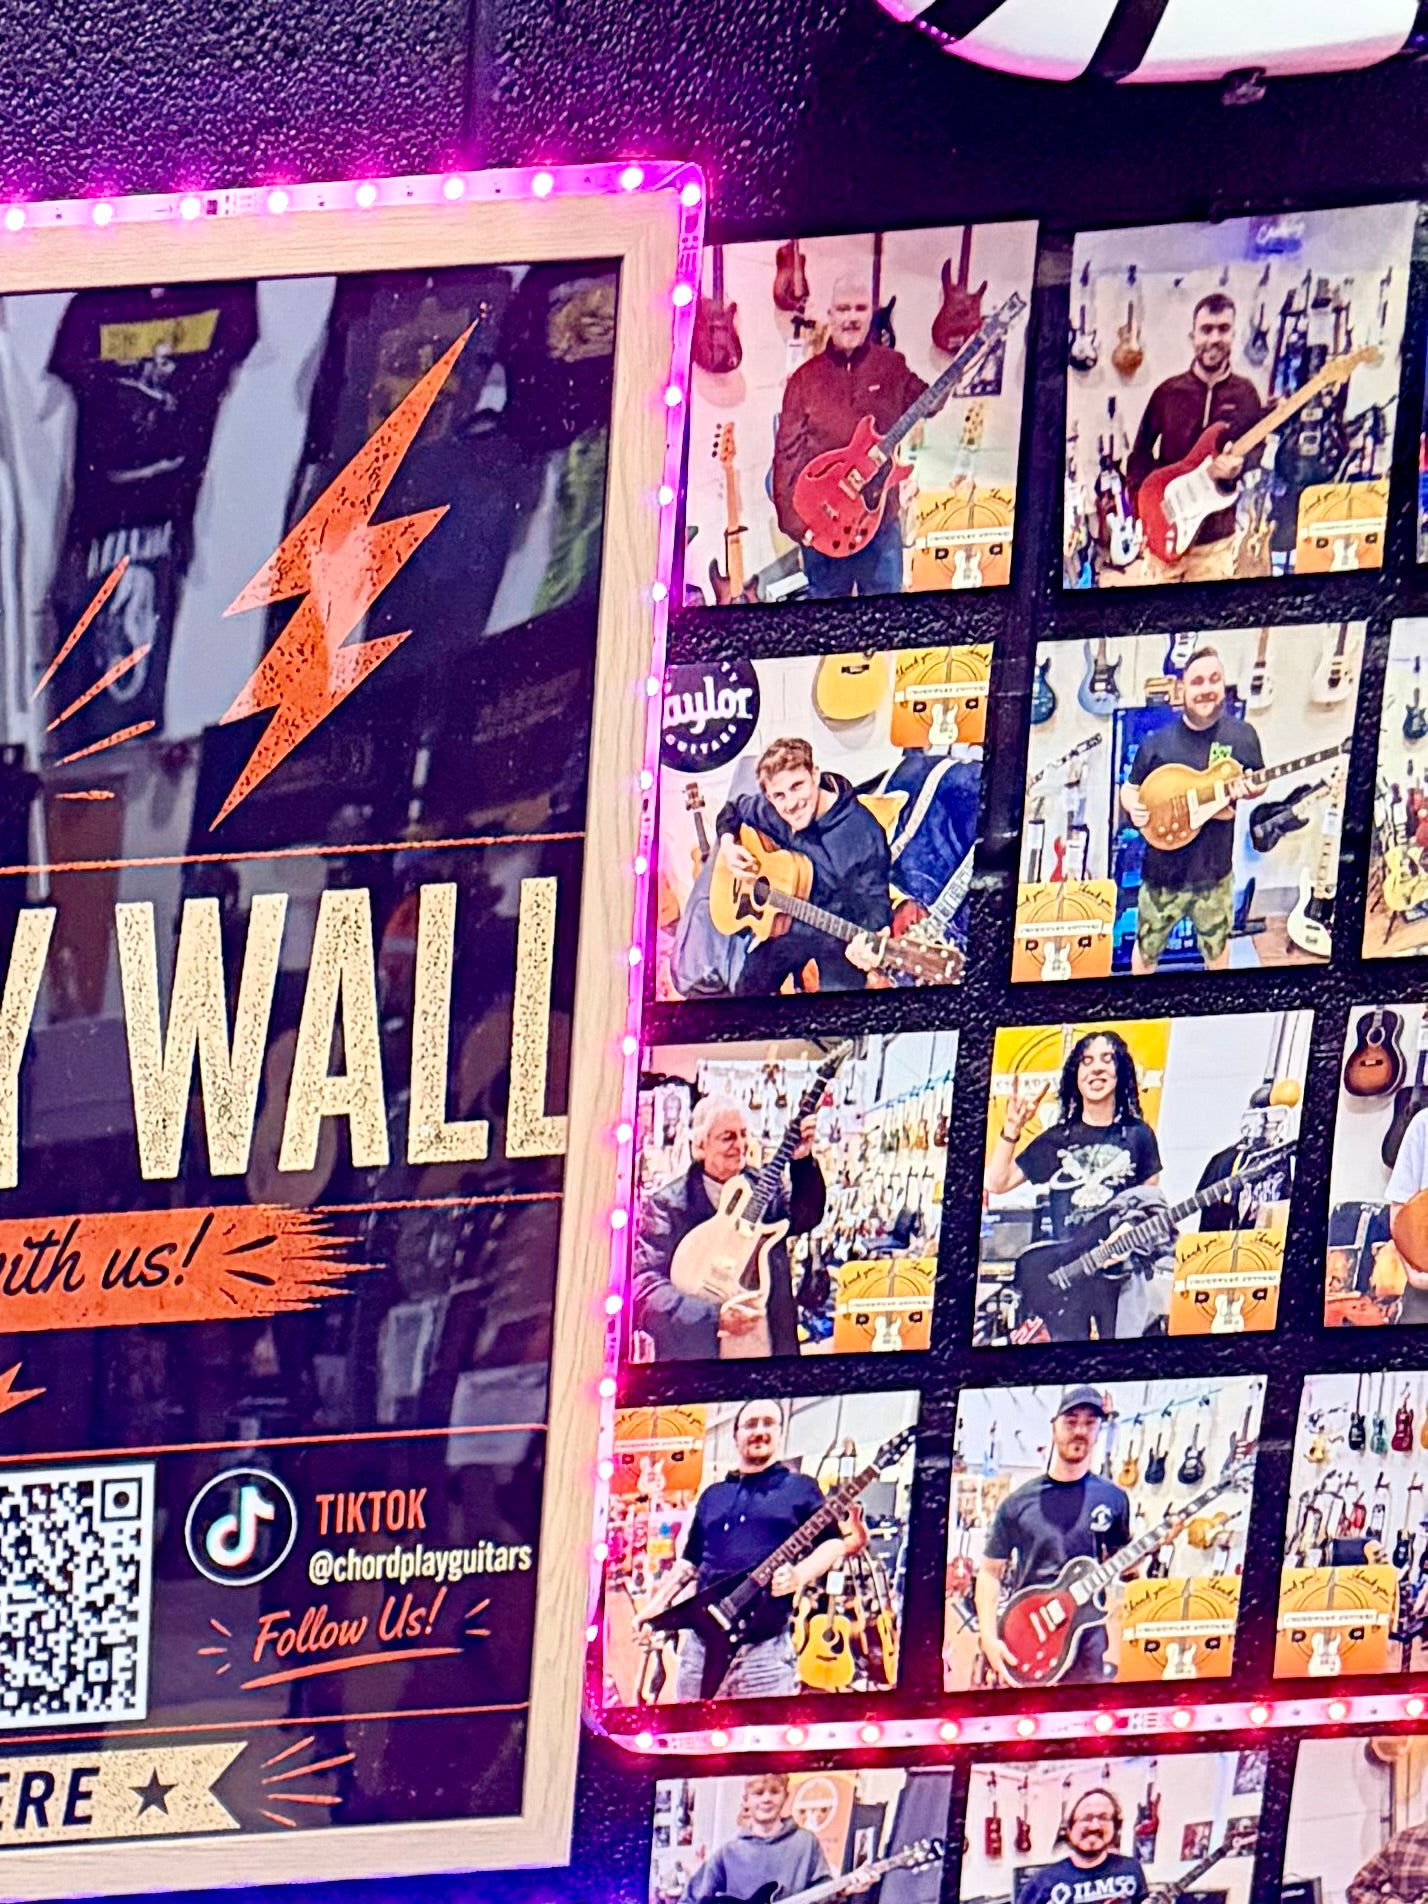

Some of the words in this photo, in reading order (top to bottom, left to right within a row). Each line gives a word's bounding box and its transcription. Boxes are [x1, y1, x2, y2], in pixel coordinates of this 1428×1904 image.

[662, 675, 754, 735] aylor
[115, 876, 568, 1182] WALL
[101, 1211, 217, 1291] us!
[315, 1487, 427, 1536] TIKTOK
[308, 1539, 532, 1587] @chordplayguitars
[251, 1609, 370, 1664] Follow
[378, 1587, 448, 1642] Us!
